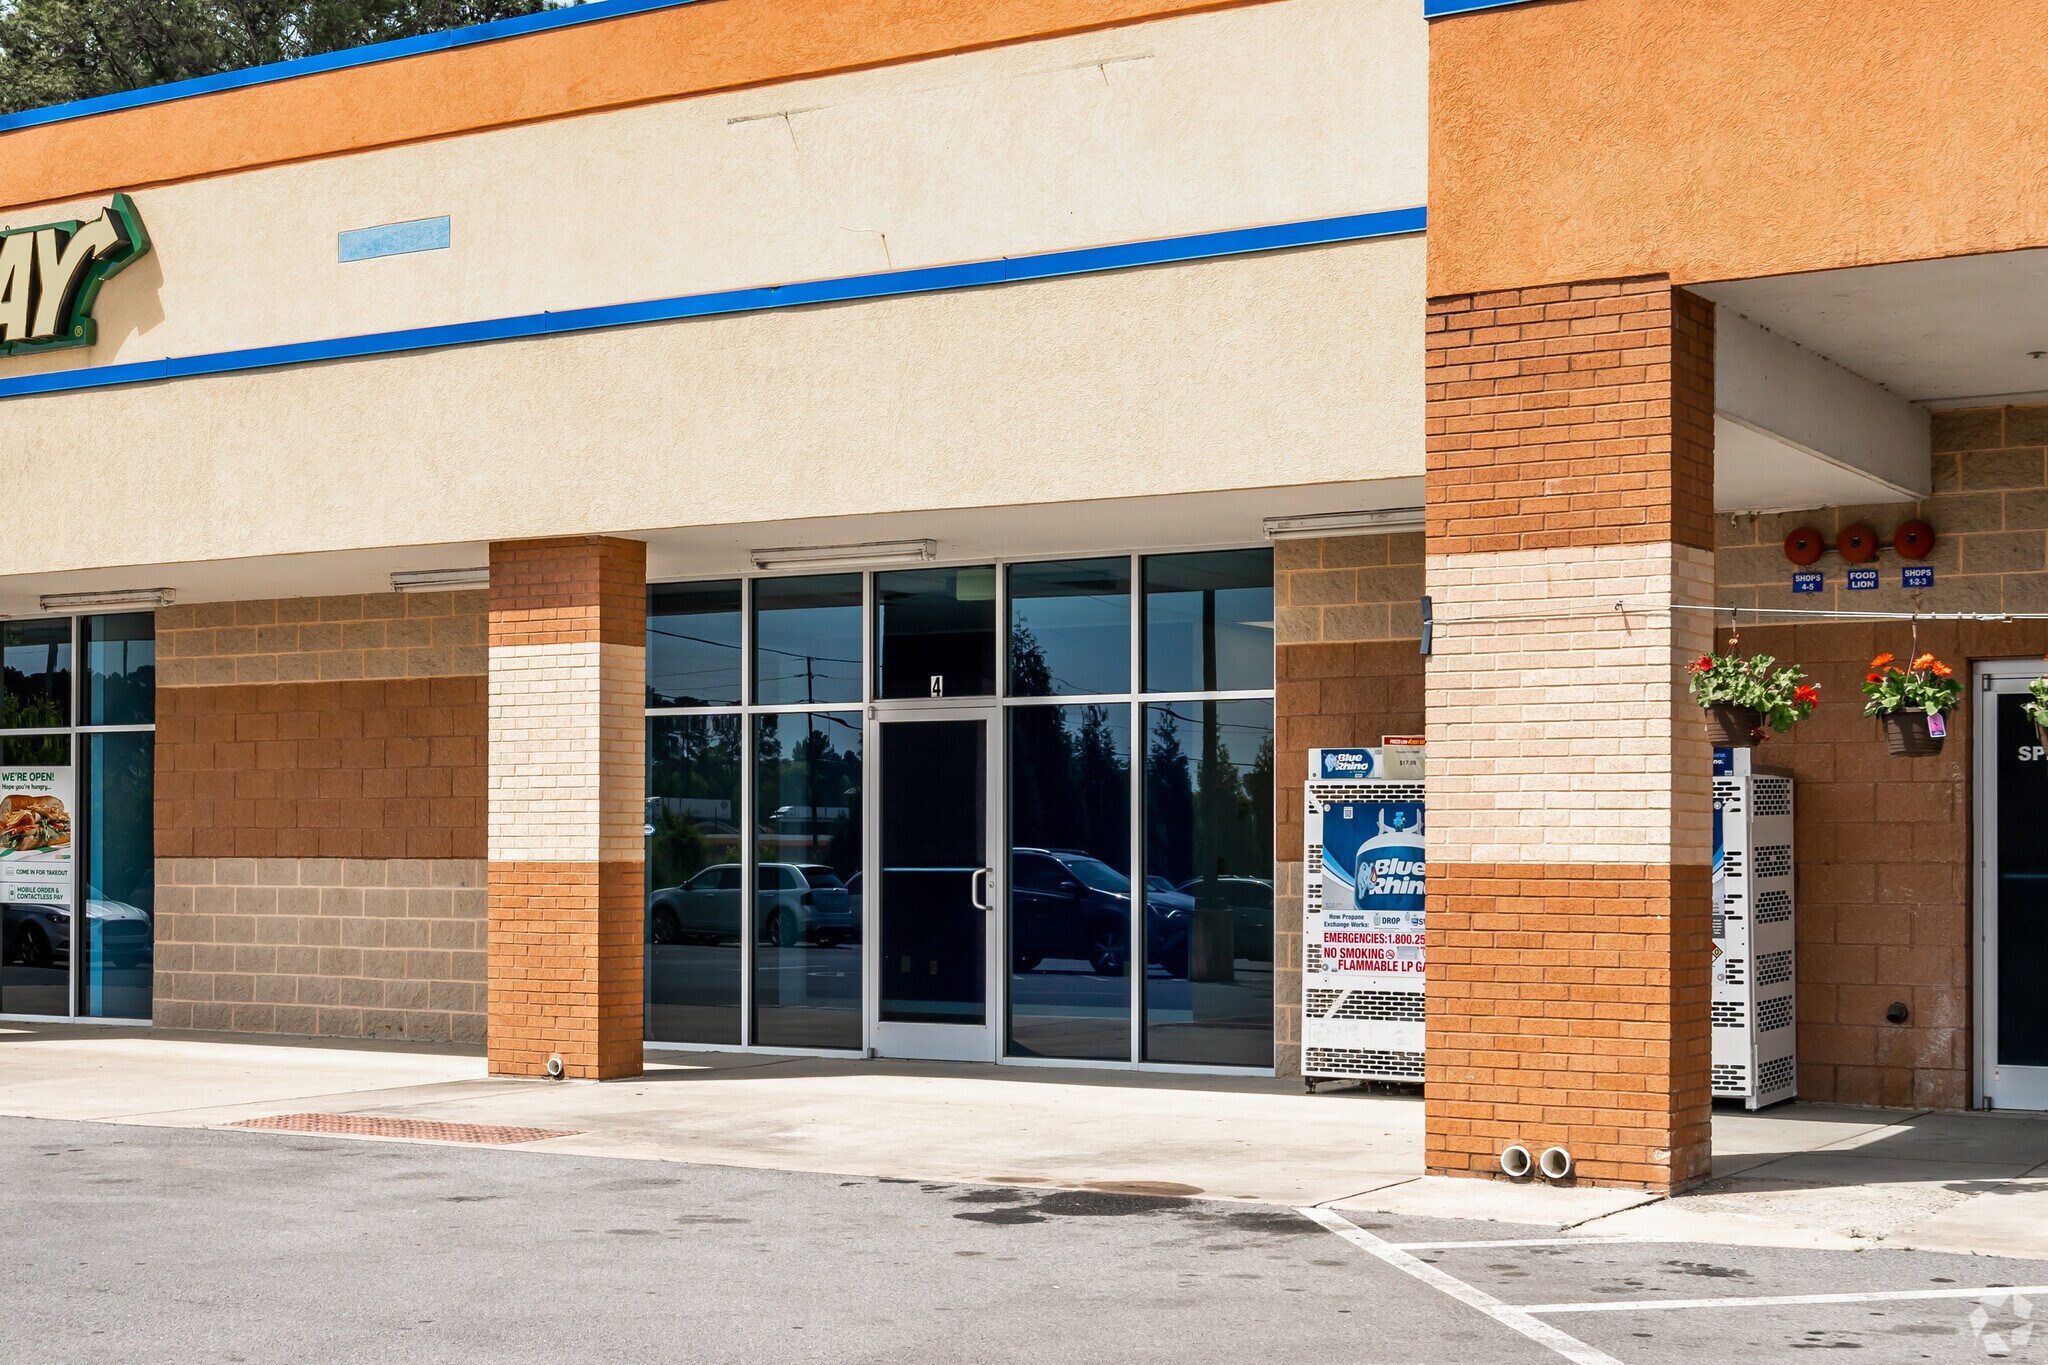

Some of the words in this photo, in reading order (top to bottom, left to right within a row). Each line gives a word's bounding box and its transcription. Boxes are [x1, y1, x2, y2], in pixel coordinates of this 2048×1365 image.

[1850, 571, 1876, 580] FOOD
[1904, 569, 1932, 577] SHOPS
[1795, 574, 1821, 582] SHOPS
[1909, 578, 1927, 586] 1-2-3
[1801, 583, 1814, 591] 4-5
[1852, 580, 1875, 588] LION
[932, 676, 942, 697] 4
[1338, 753, 1363, 761] Blue
[2018, 746, 2048, 761] SP
[1336, 762, 1369, 770] Rhino
[2, 772, 28, 781] WE'RE
[29, 772, 54, 781] OPEN!
[1375, 858, 1425, 875] Blue
[1369, 876, 1425, 895] Rhin
[1324, 947, 1337, 958] NO
[1340, 948, 1384, 959] SMOKING
[1338, 960, 1398, 972] FLAMMABLE
[1401, 961, 1413, 972] LP
